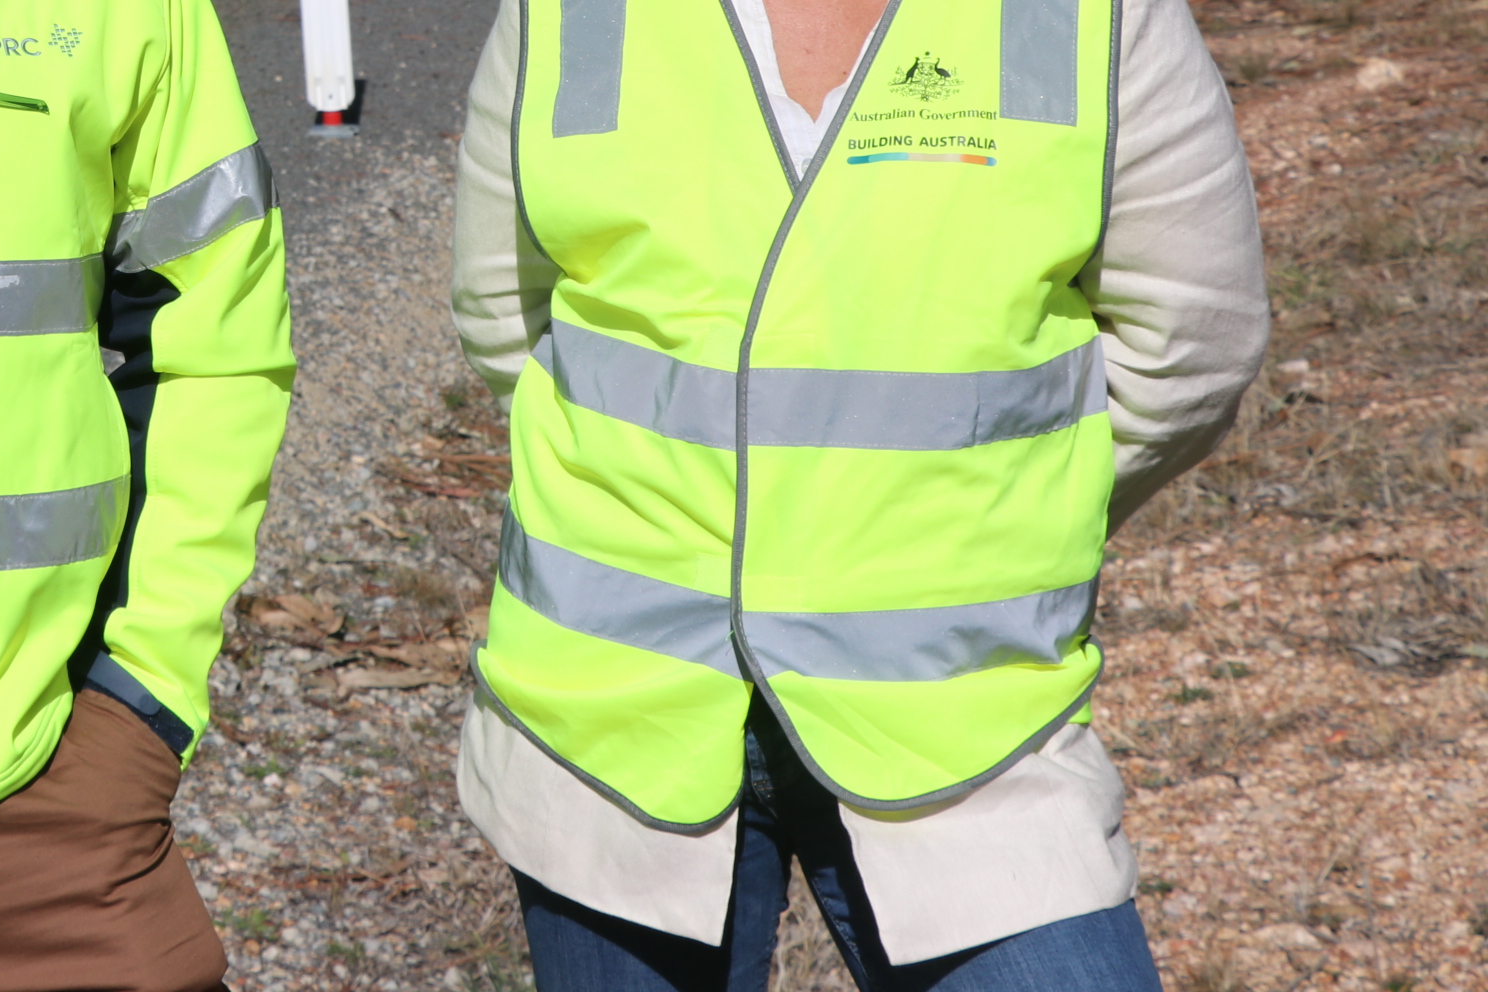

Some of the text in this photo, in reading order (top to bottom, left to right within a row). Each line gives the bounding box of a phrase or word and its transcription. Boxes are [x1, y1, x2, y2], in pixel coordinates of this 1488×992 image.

[849, 108, 998, 122] Australian Government
[848, 135, 997, 150] BUILDING AUSTRALIA
